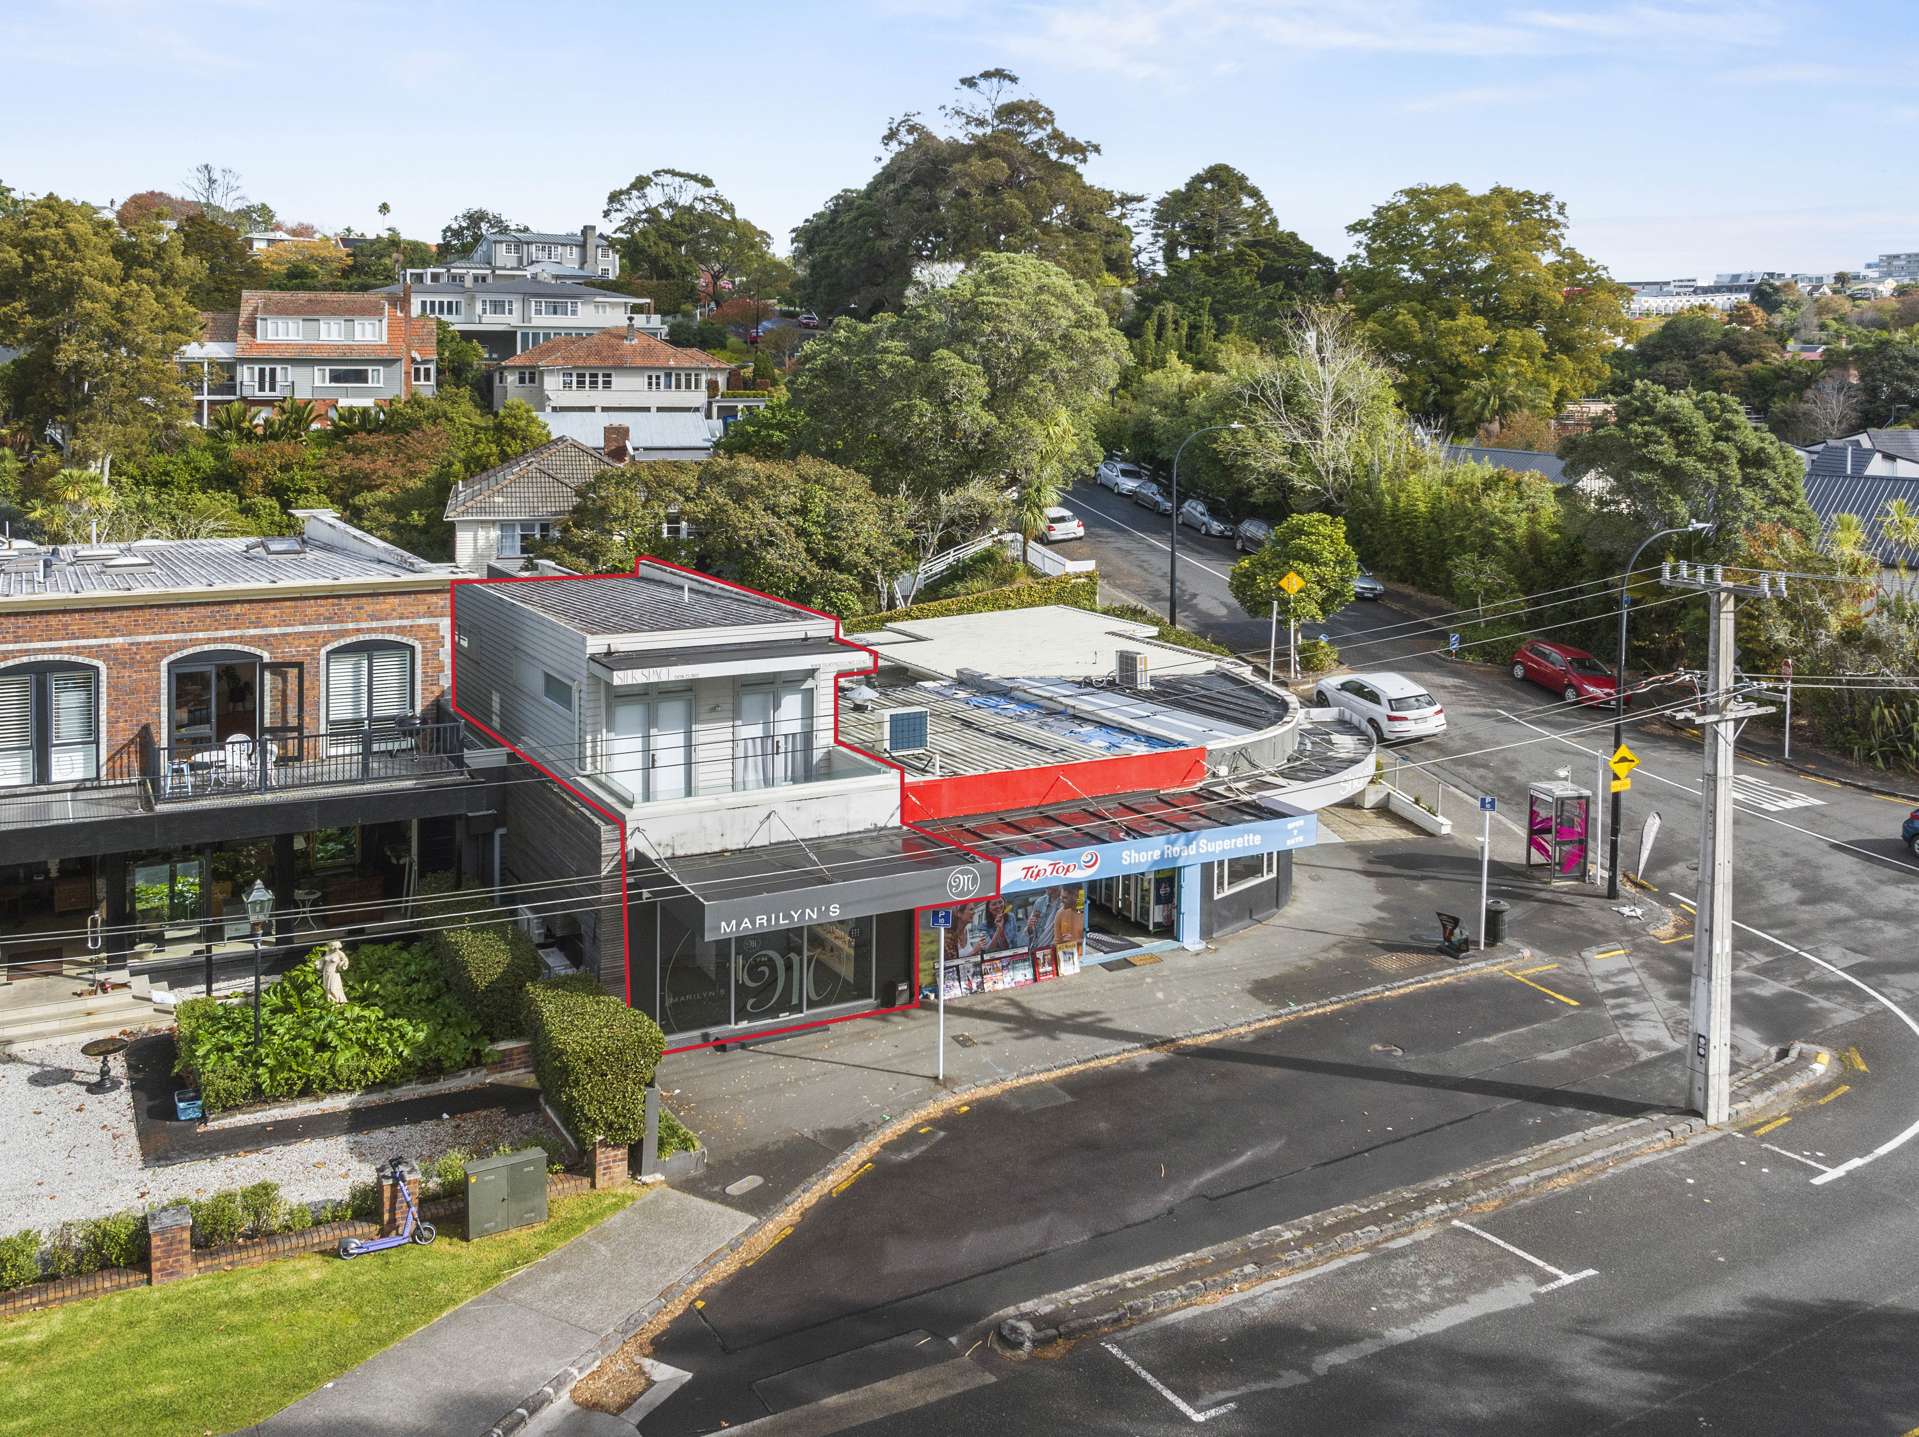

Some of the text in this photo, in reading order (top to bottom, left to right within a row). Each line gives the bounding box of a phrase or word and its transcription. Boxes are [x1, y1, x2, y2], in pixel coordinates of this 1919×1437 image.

[1121, 833, 1262, 865] Shore Road Superette
[1021, 862, 1076, 881] Tip Top
[720, 904, 840, 934] MARILYN'S
